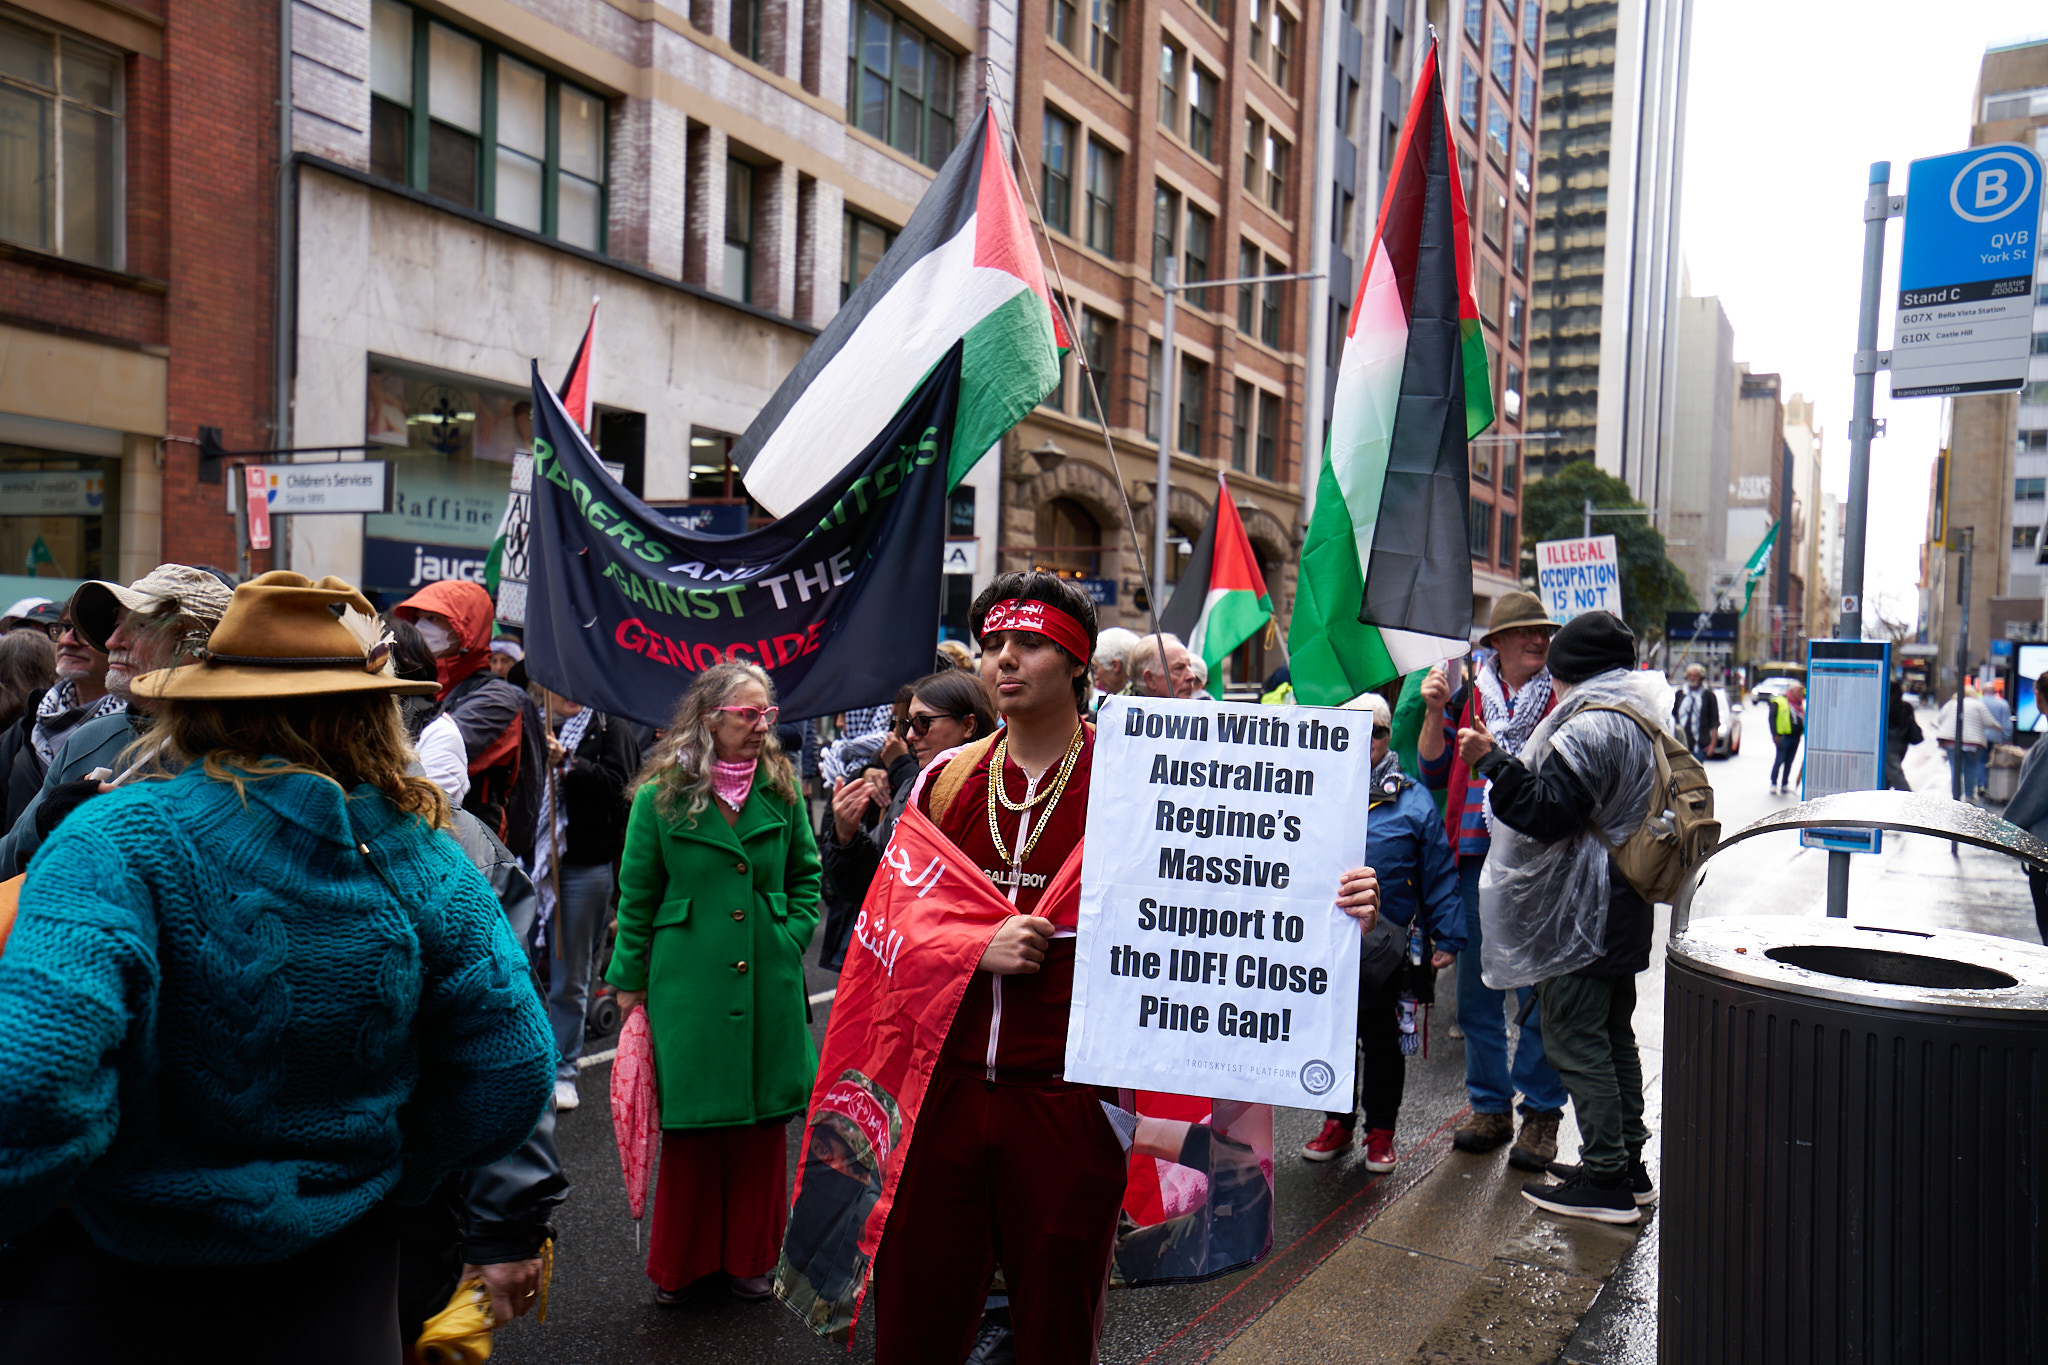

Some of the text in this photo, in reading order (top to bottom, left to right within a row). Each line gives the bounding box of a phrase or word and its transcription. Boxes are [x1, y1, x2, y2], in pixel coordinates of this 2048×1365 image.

[1975, 168, 2008, 208] B
[1991, 230, 2029, 249] QVB
[1980, 249, 2027, 264] York St
[1904, 287, 1961, 306] Stand C
[1991, 285, 2025, 296] 200043
[1994, 281, 2008, 289] BUS
[1903, 312, 1933, 324] 607X
[1957, 309, 1977, 317] Vista
[1978, 306, 2006, 315] Station
[1901, 332, 1930, 344] 610X
[1936, 330, 1959, 339] Castle
[1897, 385, 1961, 397] transportnsw.info
[286, 472, 373, 488] Children's Services
[1546, 540, 1606, 565] ILLEGAL
[667, 560, 773, 582] AND
[757, 546, 855, 610] THE
[1540, 562, 1617, 588] OCCUPATION
[1552, 586, 1607, 611] IS NOT
[1002, 616, 1044, 630] لتحرير
[614, 617, 827, 672] GENOCIDE
[1124, 706, 1350, 752] Down With the
[1149, 754, 1314, 797] Australian
[1154, 800, 1301, 842] Regime’s
[983, 868, 1047, 889] SALLYBOY
[1158, 847, 1290, 889] Massive
[1137, 897, 1305, 943] Support to
[1110, 944, 1328, 996] the IDF! Close
[1138, 994, 1292, 1044] Pine Gap!
[1186, 1058, 1297, 1079] TROTSKYIST PLATFORM
